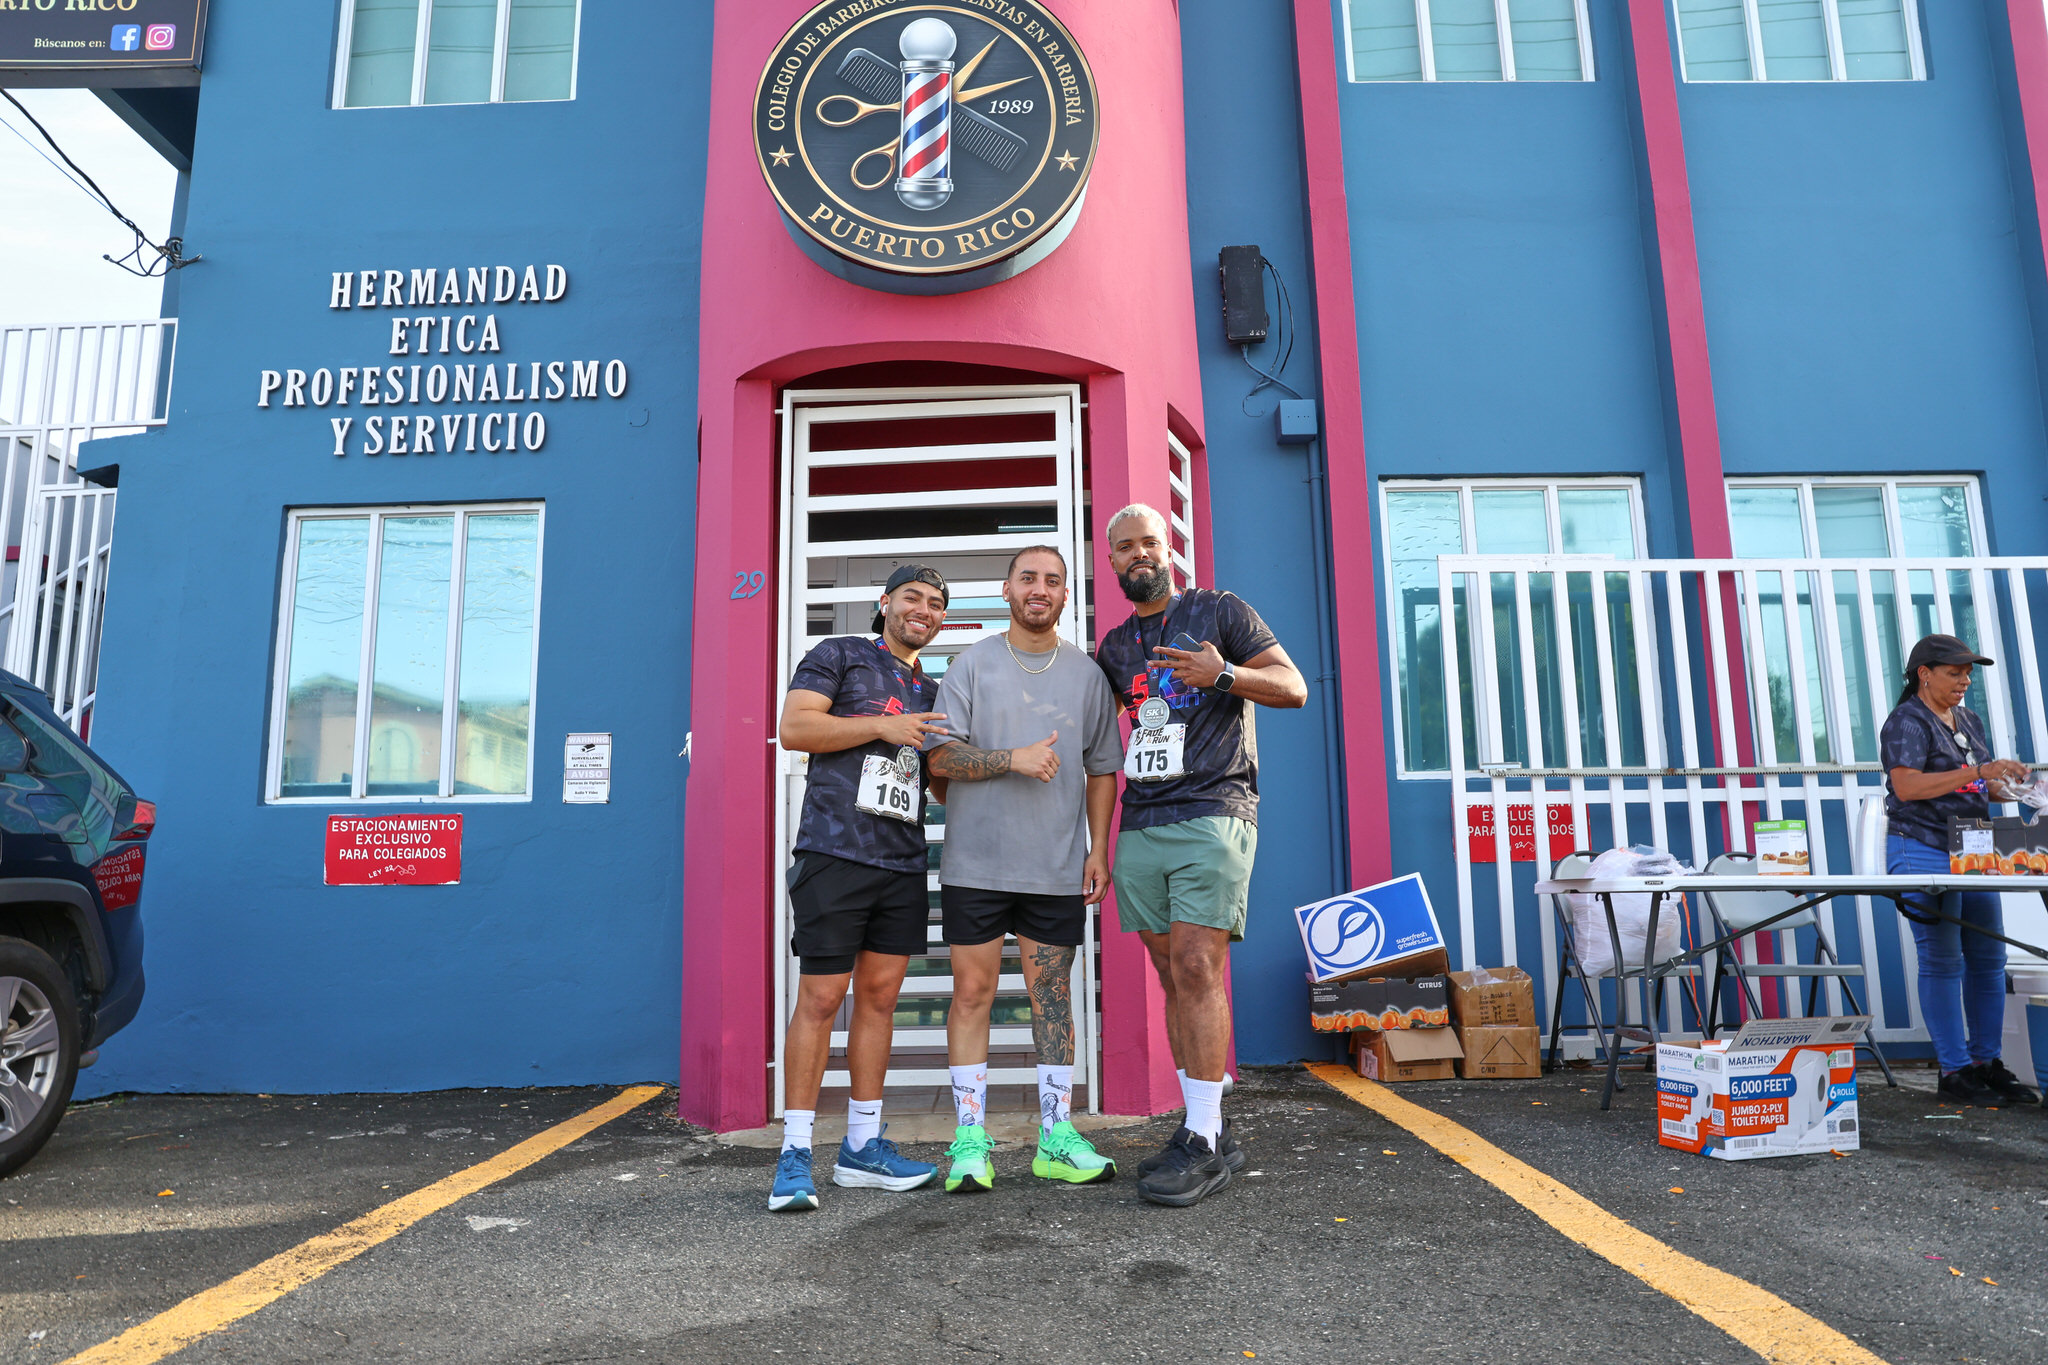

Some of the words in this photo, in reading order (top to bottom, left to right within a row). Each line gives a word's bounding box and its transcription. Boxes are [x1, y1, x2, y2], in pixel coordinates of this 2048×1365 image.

[34, 37, 86, 48] Búscanos
[89, 39, 106, 48] en:
[768, 55, 802, 131] COLEGIO
[794, 32, 821, 57] DE
[1023, 19, 1050, 43] EN
[988, 99, 1034, 114] 1989
[807, 202, 945, 259] PUERTO
[954, 207, 1036, 255] RICO
[329, 264, 568, 309] HERMANDAD
[389, 314, 500, 355] ETICA
[257, 358, 628, 408] PROFESIONALISMO
[330, 417, 353, 456] Y
[363, 411, 546, 456] SERVICIO
[730, 570, 766, 600] 29
[568, 736, 608, 744] WARNING
[1152, 735, 1170, 744] RUN
[1134, 749, 1168, 773] 175
[571, 770, 603, 779] AVISO
[876, 783, 910, 812] 169
[331, 819, 457, 832] ESTACIONAMIENTO
[355, 833, 431, 845] EXCLUSIVO
[339, 848, 369, 860] PARA
[373, 847, 447, 860] COLEGIADOS
[368, 868, 382, 879] LEY
[384, 864, 393, 873] 22
[1396, 931, 1428, 944] superfresh
[1397, 936, 1434, 951] growers.com
[1418, 981, 1443, 989] CITRUS
[1740, 1034, 1812, 1047] MARATHON
[1659, 1048, 1693, 1059] MARATHON
[1728, 1055, 1777, 1066] MARATHON
[1660, 1080, 1678, 1091] 6,000
[1731, 1080, 1762, 1097] 6,000
[1660, 1093, 1676, 1102] JUMBO
[1829, 1086, 1837, 1100] 6
[1837, 1087, 1855, 1097] ROLLS
[1660, 1100, 1675, 1108] TOILET
[1675, 1103, 1689, 1111] PAPER
[1731, 1104, 1760, 1116] JUMBO
[1762, 1103, 1783, 1114] 2-PLY
[1731, 1115, 1760, 1127] TOILET
[1761, 1114, 1785, 1125] PAPER
